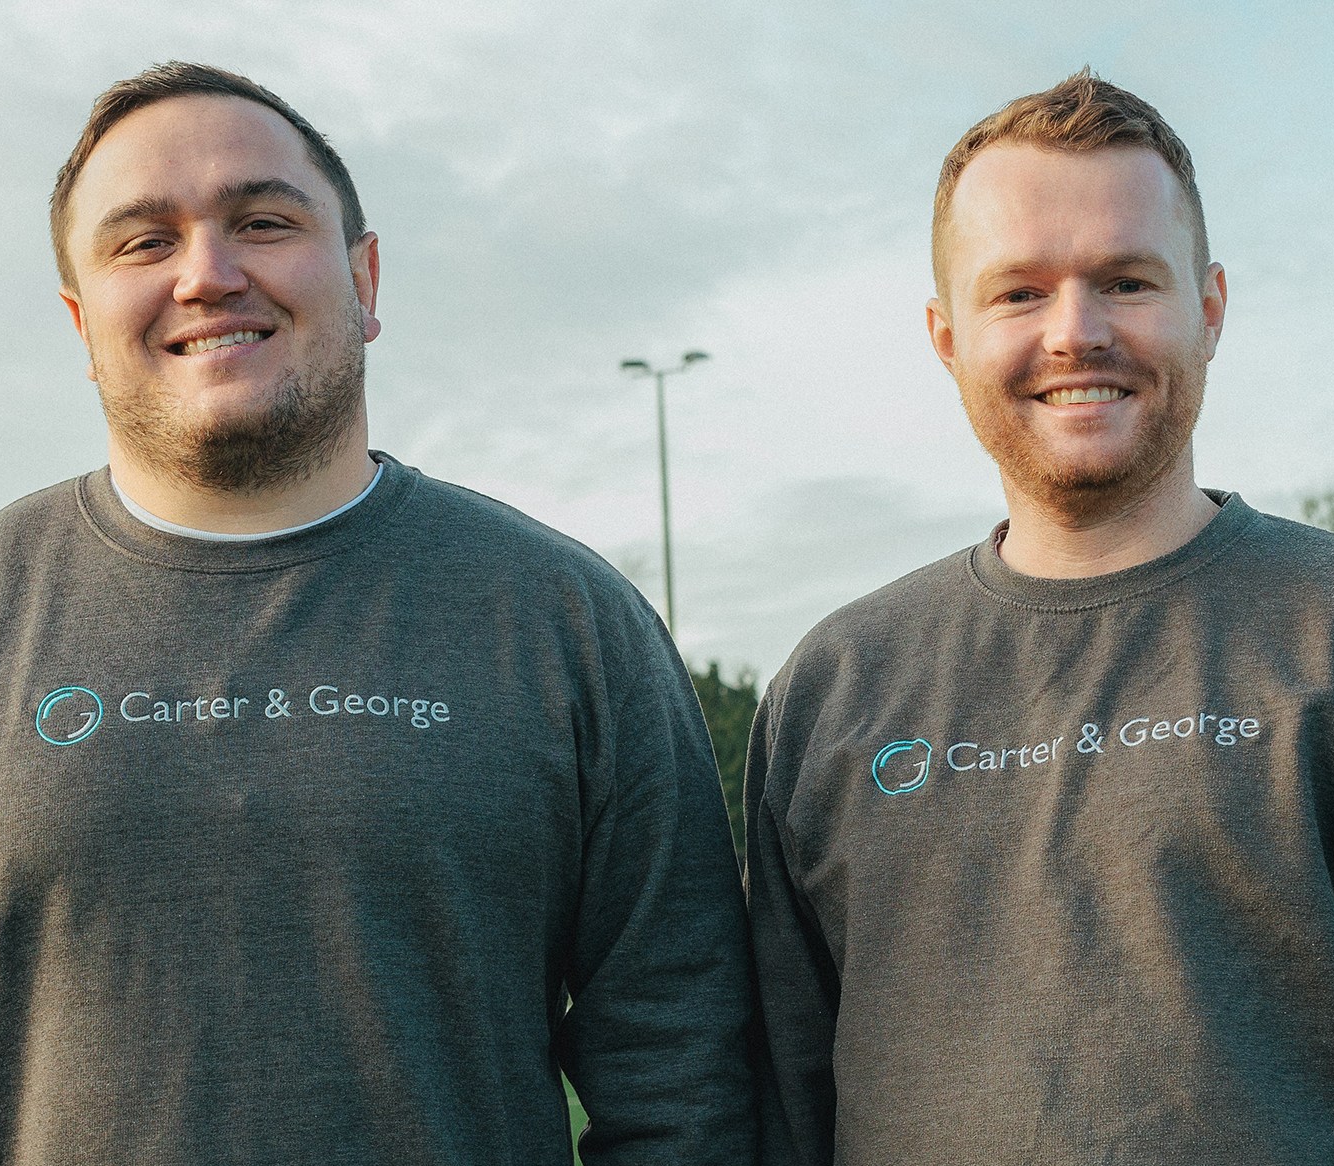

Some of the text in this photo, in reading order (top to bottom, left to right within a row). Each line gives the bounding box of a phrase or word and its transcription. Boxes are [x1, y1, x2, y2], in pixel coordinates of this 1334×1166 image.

[120, 685, 452, 729] Carter & George
[946, 712, 1262, 772] Carter & George
